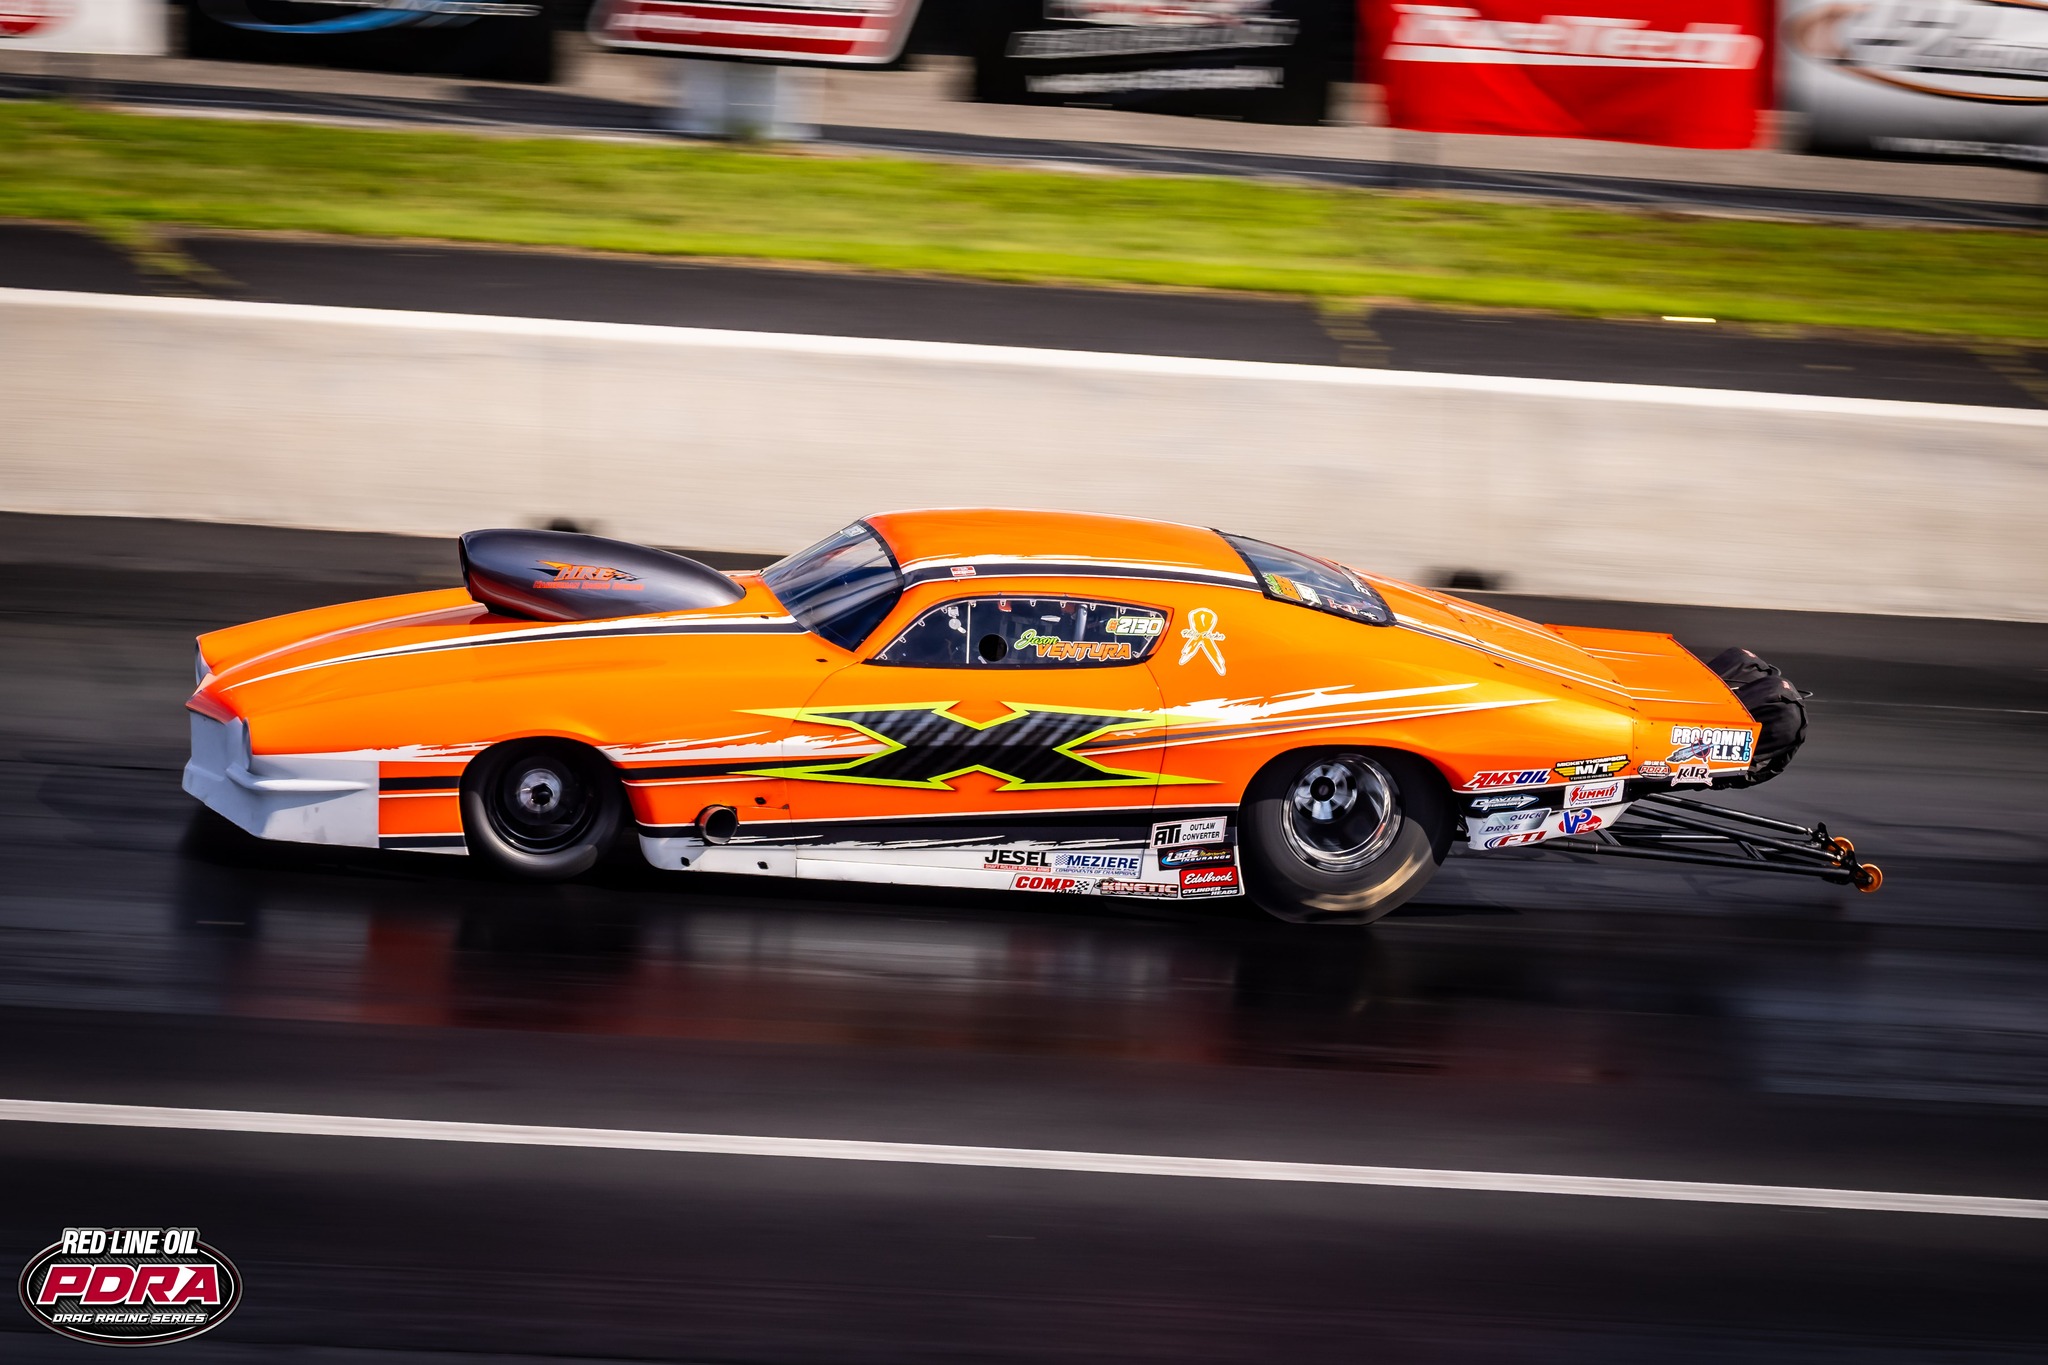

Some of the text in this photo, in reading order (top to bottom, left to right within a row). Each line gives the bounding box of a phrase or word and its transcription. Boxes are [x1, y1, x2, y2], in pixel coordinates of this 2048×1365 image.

[554, 566, 616, 581] HRE
[1107, 617, 1165, 635] #2130
[1015, 630, 1060, 649] Jason
[1037, 642, 1131, 660] VENTURA
[1672, 727, 1746, 746] PRO COMM
[1586, 755, 1626, 764] THOMPSON
[1712, 746, 1742, 760] E.L.S.
[1576, 763, 1611, 775] M/T
[1641, 766, 1668, 774] PDRA
[1465, 770, 1549, 788] AMSOIL
[1510, 812, 1541, 821] QUICK
[1563, 808, 1592, 834] VP
[1190, 822, 1215, 831] OUTLAW
[1485, 824, 1520, 832] DRIVE
[1154, 824, 1182, 846] ATI
[1182, 831, 1220, 841] CONVERTER
[1498, 831, 1547, 846] FTI
[985, 850, 1051, 867] JESEL
[1067, 855, 1140, 869] MEZIERE
[1016, 876, 1075, 890] COMP
[1184, 871, 1233, 885] Edelbrock
[1102, 882, 1178, 893] KINETIC
